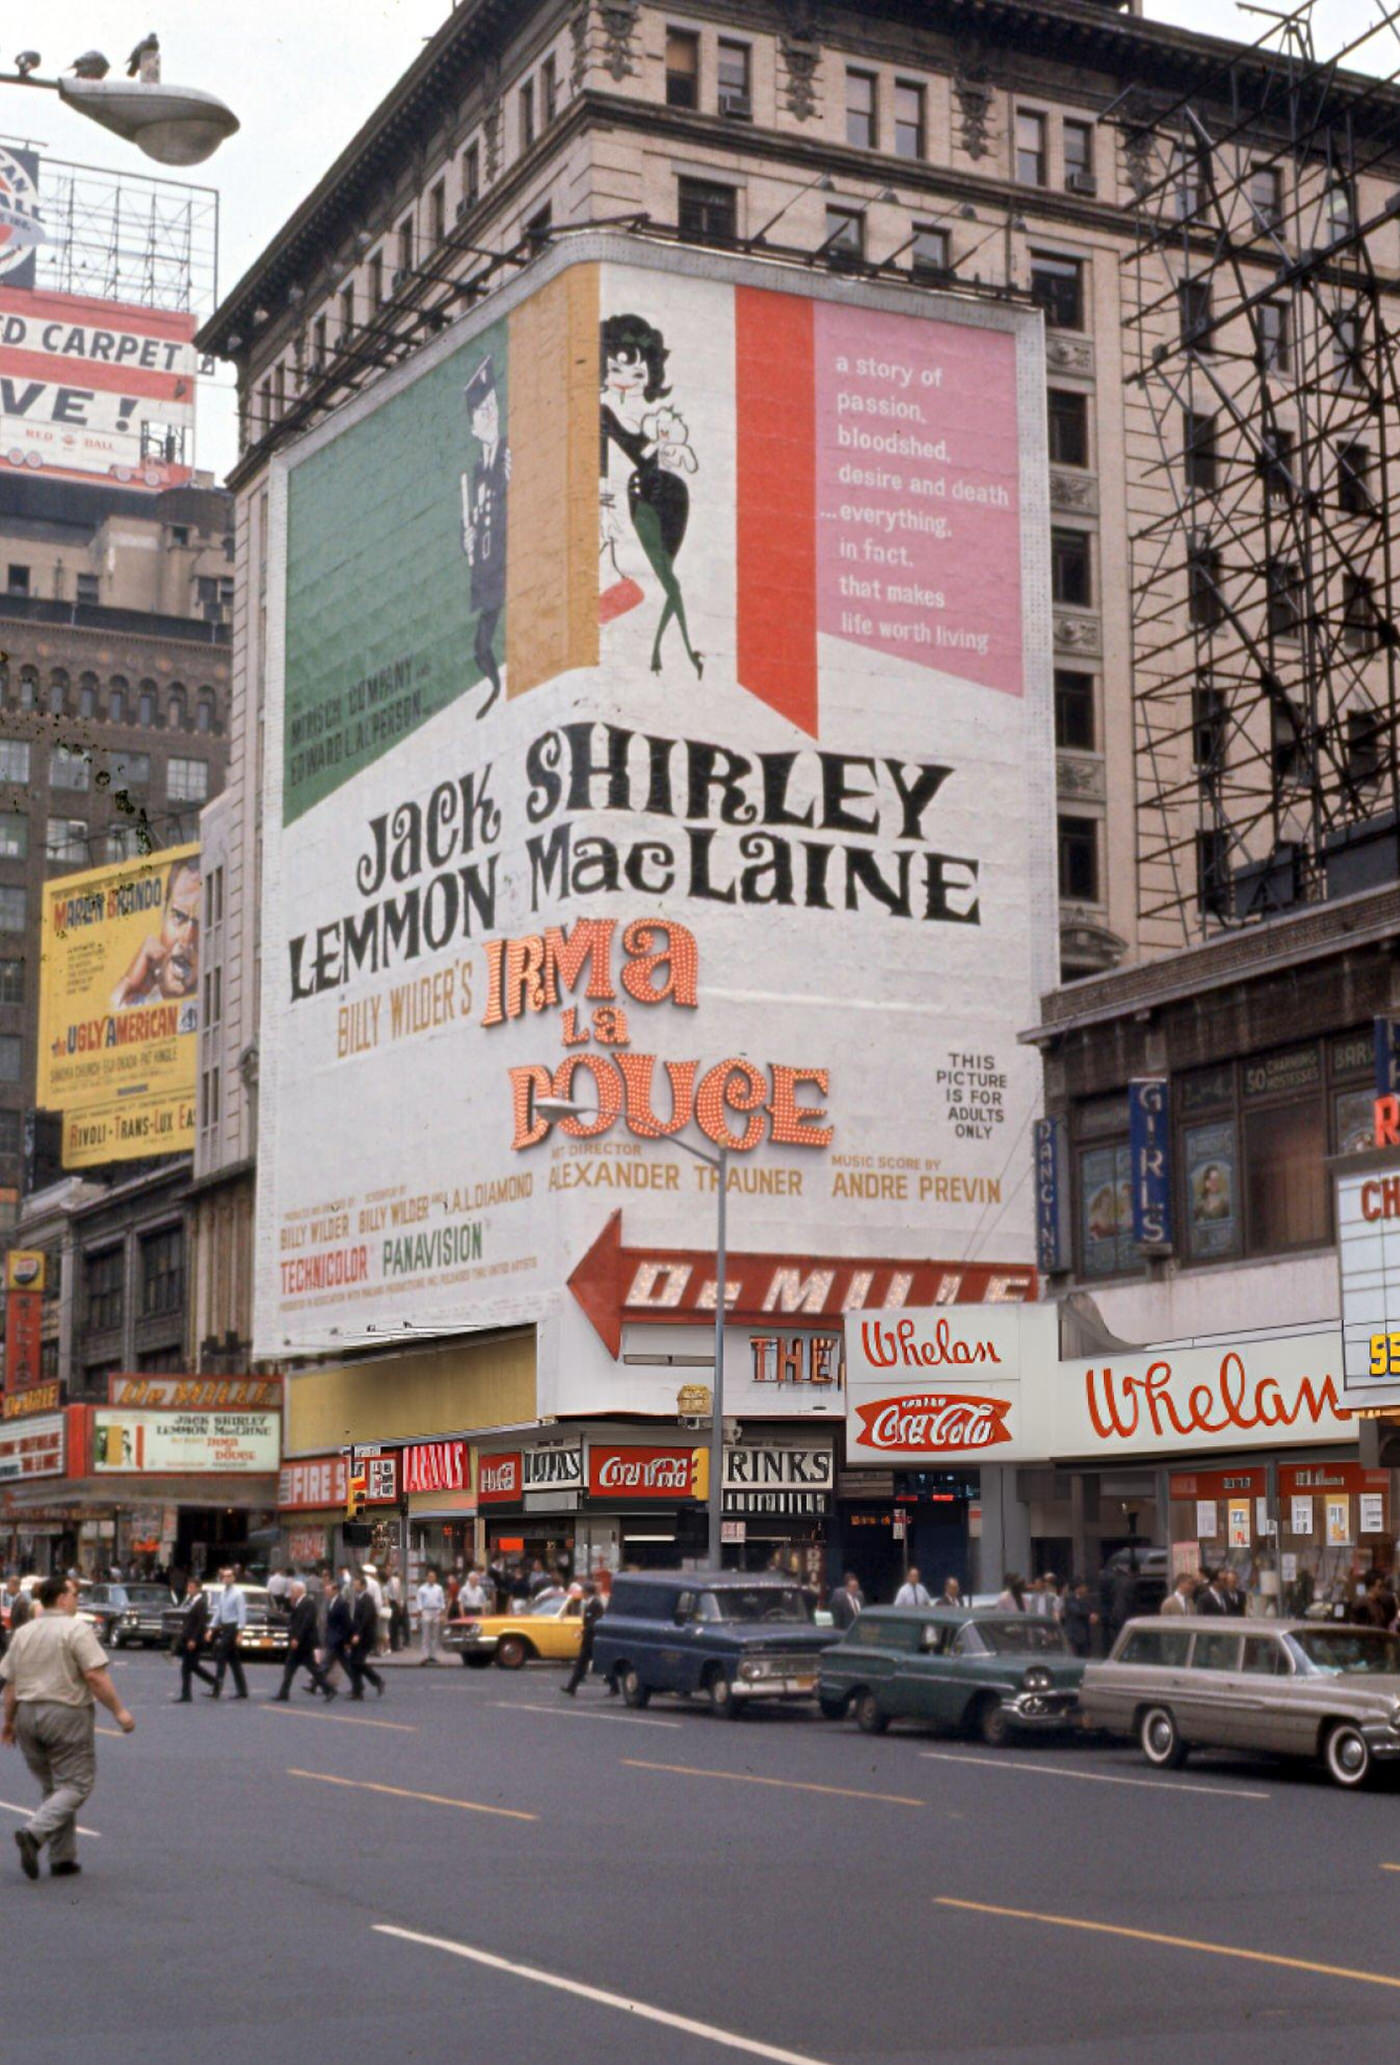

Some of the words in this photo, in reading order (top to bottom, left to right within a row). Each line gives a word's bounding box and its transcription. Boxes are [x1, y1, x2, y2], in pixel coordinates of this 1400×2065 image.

[0, 314, 27, 345] D
[42, 324, 183, 371] CARPET
[837, 358, 848, 373] a
[856, 358, 912, 388] story
[922, 367, 943, 387] of
[839, 464, 902, 489] desire
[910, 477, 946, 497] and
[952, 479, 1010, 506] death
[840, 537, 857, 560] in
[839, 575, 880, 600] that
[886, 584, 945, 609] makes
[842, 611, 873, 636] life
[879, 620, 931, 643] worth
[936, 625, 989, 656] living
[526, 722, 956, 840] SHIRLEY
[289, 852, 501, 1003] LEMMON
[337, 994, 380, 1059] BILLY
[389, 958, 473, 1040] WILDER'S
[67, 1015, 109, 1055] UGLY
[105, 1006, 178, 1048] AMERICAN
[936, 1070, 1007, 1089] PICTURE
[947, 1052, 995, 1071] THIS
[508, 1052, 836, 1151] DOUCE
[946, 1088, 963, 1103] IS
[970, 1090, 1002, 1105] FOR
[948, 1107, 1005, 1123] ADULTS
[70, 1122, 106, 1149] RIVOLI
[569, 1143, 643, 1157] DIRECTOR
[955, 1123, 992, 1139] ONLY
[549, 1161, 680, 1193] ALEXANDER
[694, 1164, 803, 1197] TRAUNER
[831, 1155, 874, 1168] MUSIC
[878, 1156, 921, 1170] SCORE
[925, 1159, 942, 1170] BY
[1139, 1083, 1165, 1243] GIRLS
[832, 1172, 908, 1200] ANDRE
[920, 1175, 1002, 1204] PREVIN
[358, 1204, 386, 1234] BILLY
[390, 1194, 430, 1228] WILDER
[280, 1244, 368, 1295] TECHNICOLOR
[383, 1221, 483, 1278] PANAVISION
[861, 1318, 1003, 1368] Whelan
[1085, 1352, 1353, 1440] Whelan
